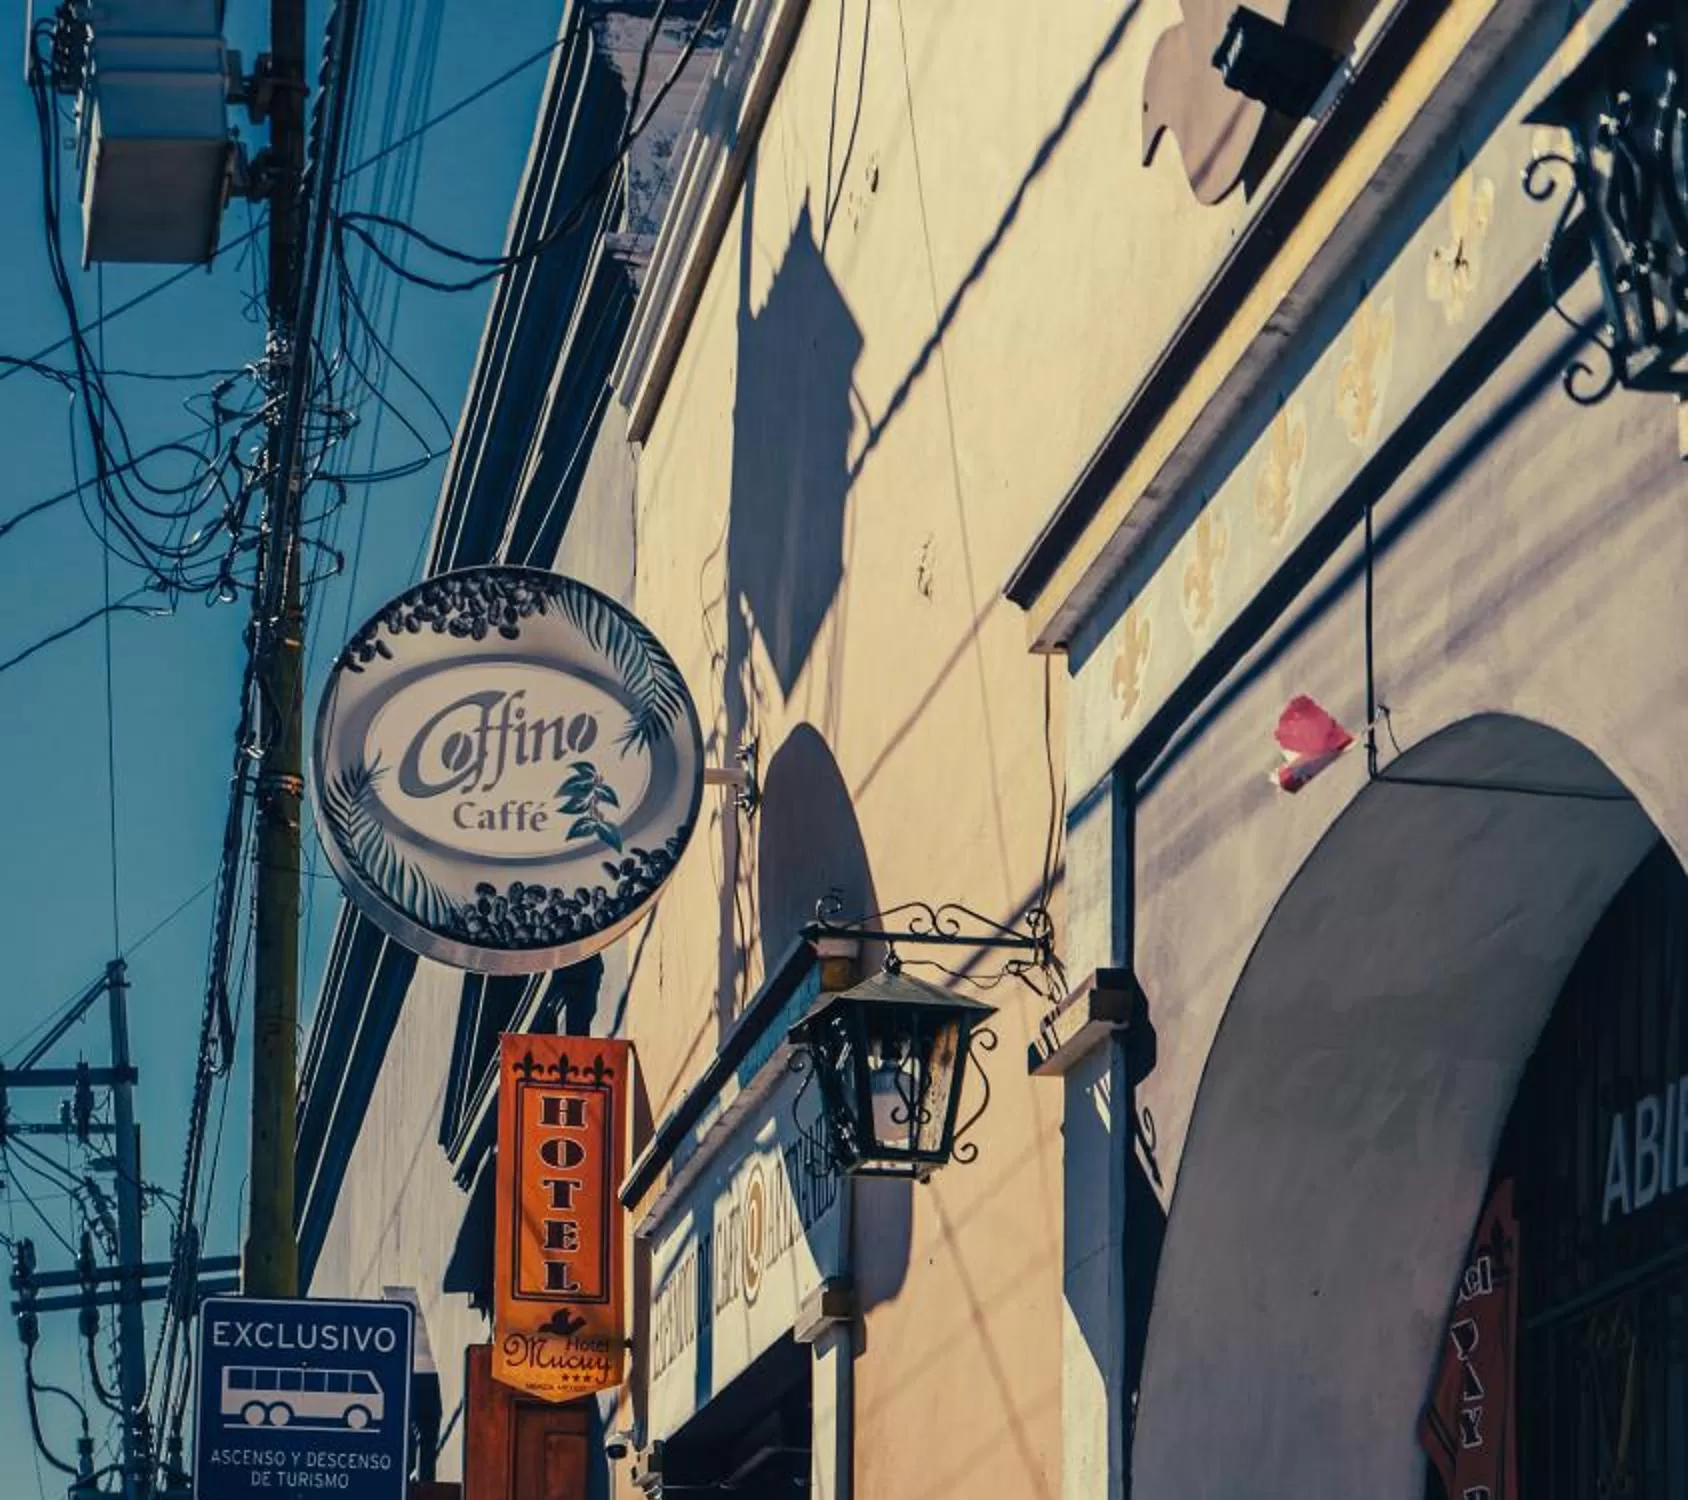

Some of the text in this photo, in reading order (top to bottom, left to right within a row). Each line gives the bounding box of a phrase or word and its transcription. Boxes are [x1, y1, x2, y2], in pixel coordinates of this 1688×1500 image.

[399, 689, 599, 798] Coffino
[452, 800, 549, 832] Caffé
[538, 1095, 588, 1292] HOTEL
[212, 1321, 396, 1353] EXCLUSIVO
[211, 1449, 392, 1471] ASCENSO Y DESCENSO
[251, 1471, 350, 1489] DE TURISMO
